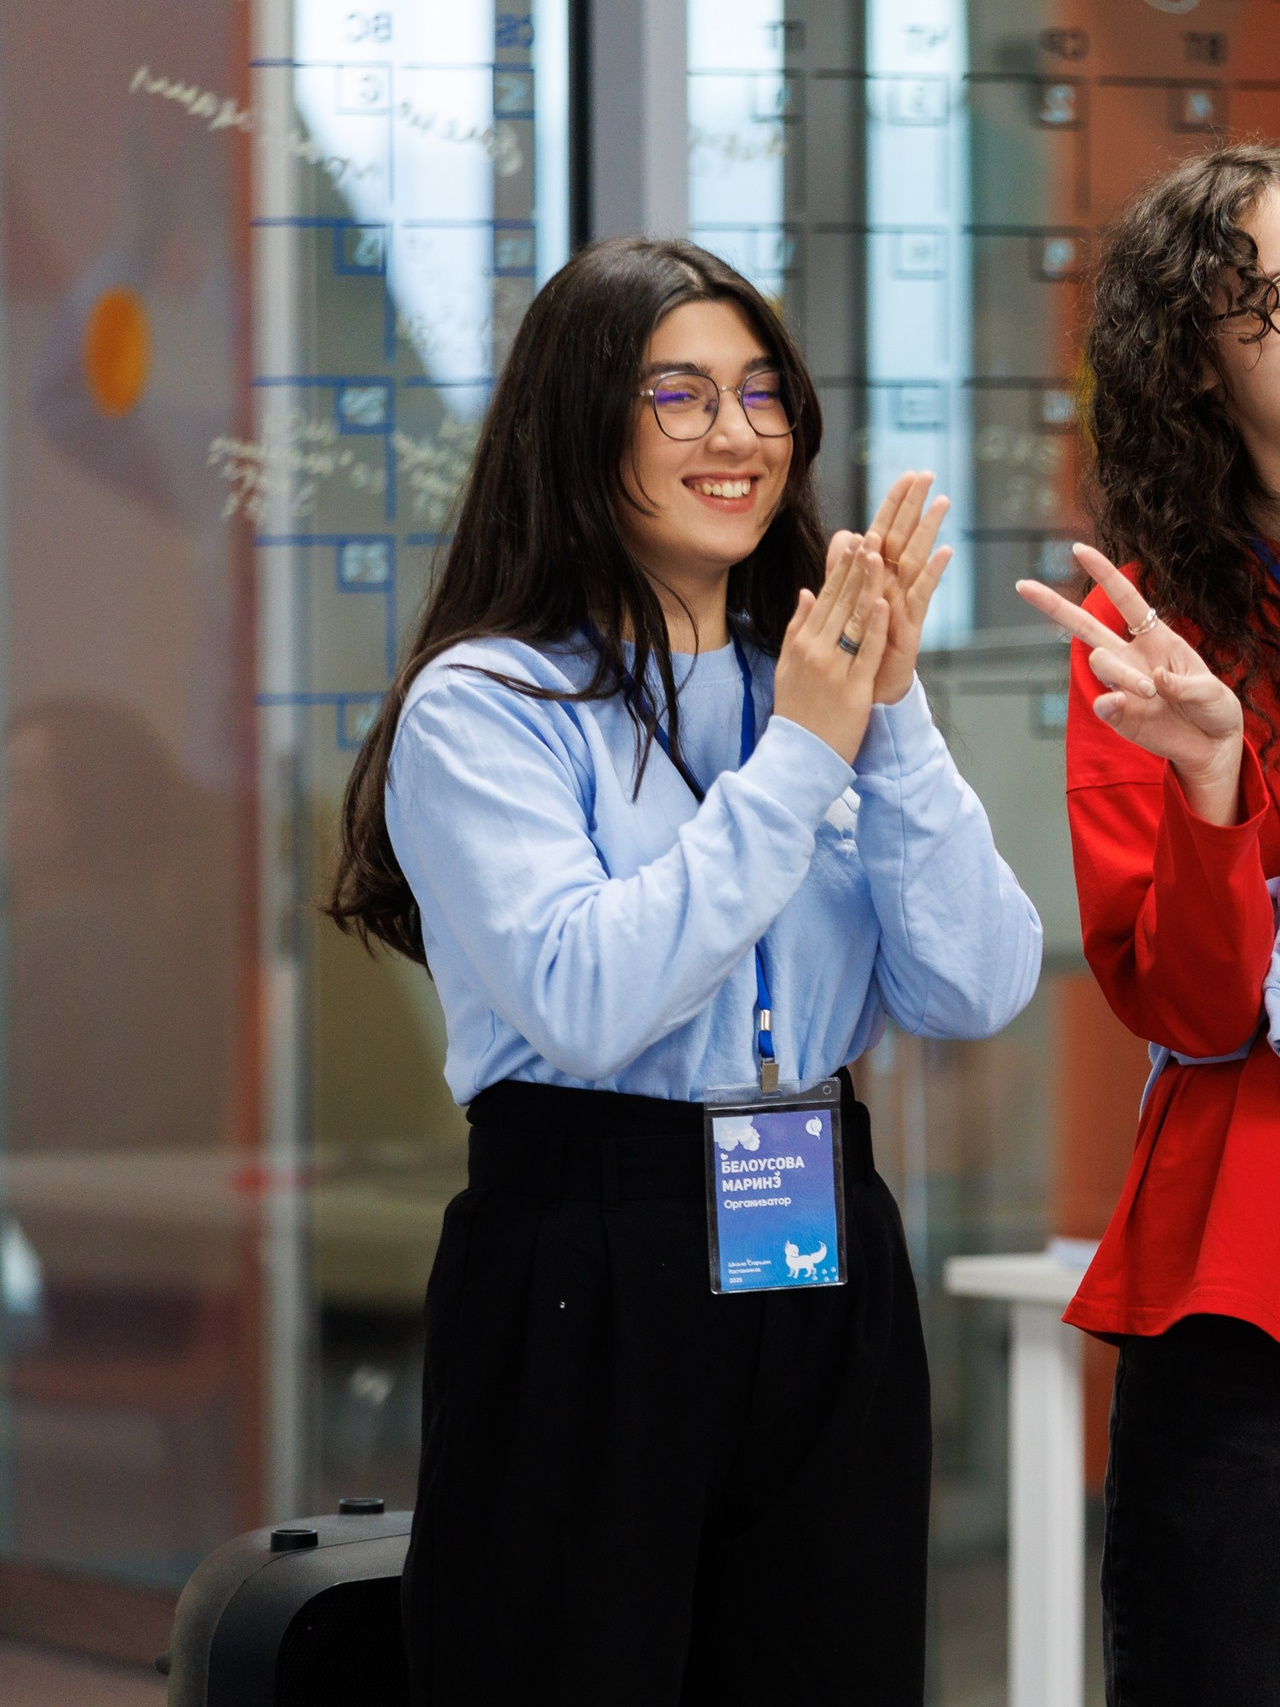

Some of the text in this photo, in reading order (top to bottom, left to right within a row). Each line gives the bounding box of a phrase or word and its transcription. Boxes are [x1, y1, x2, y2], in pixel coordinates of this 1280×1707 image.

[721, 1156, 804, 1174] БЕЛОУСОВА
[721, 1175, 782, 1192] МАРИНЭ
[723, 1196, 792, 1210] Организатор
